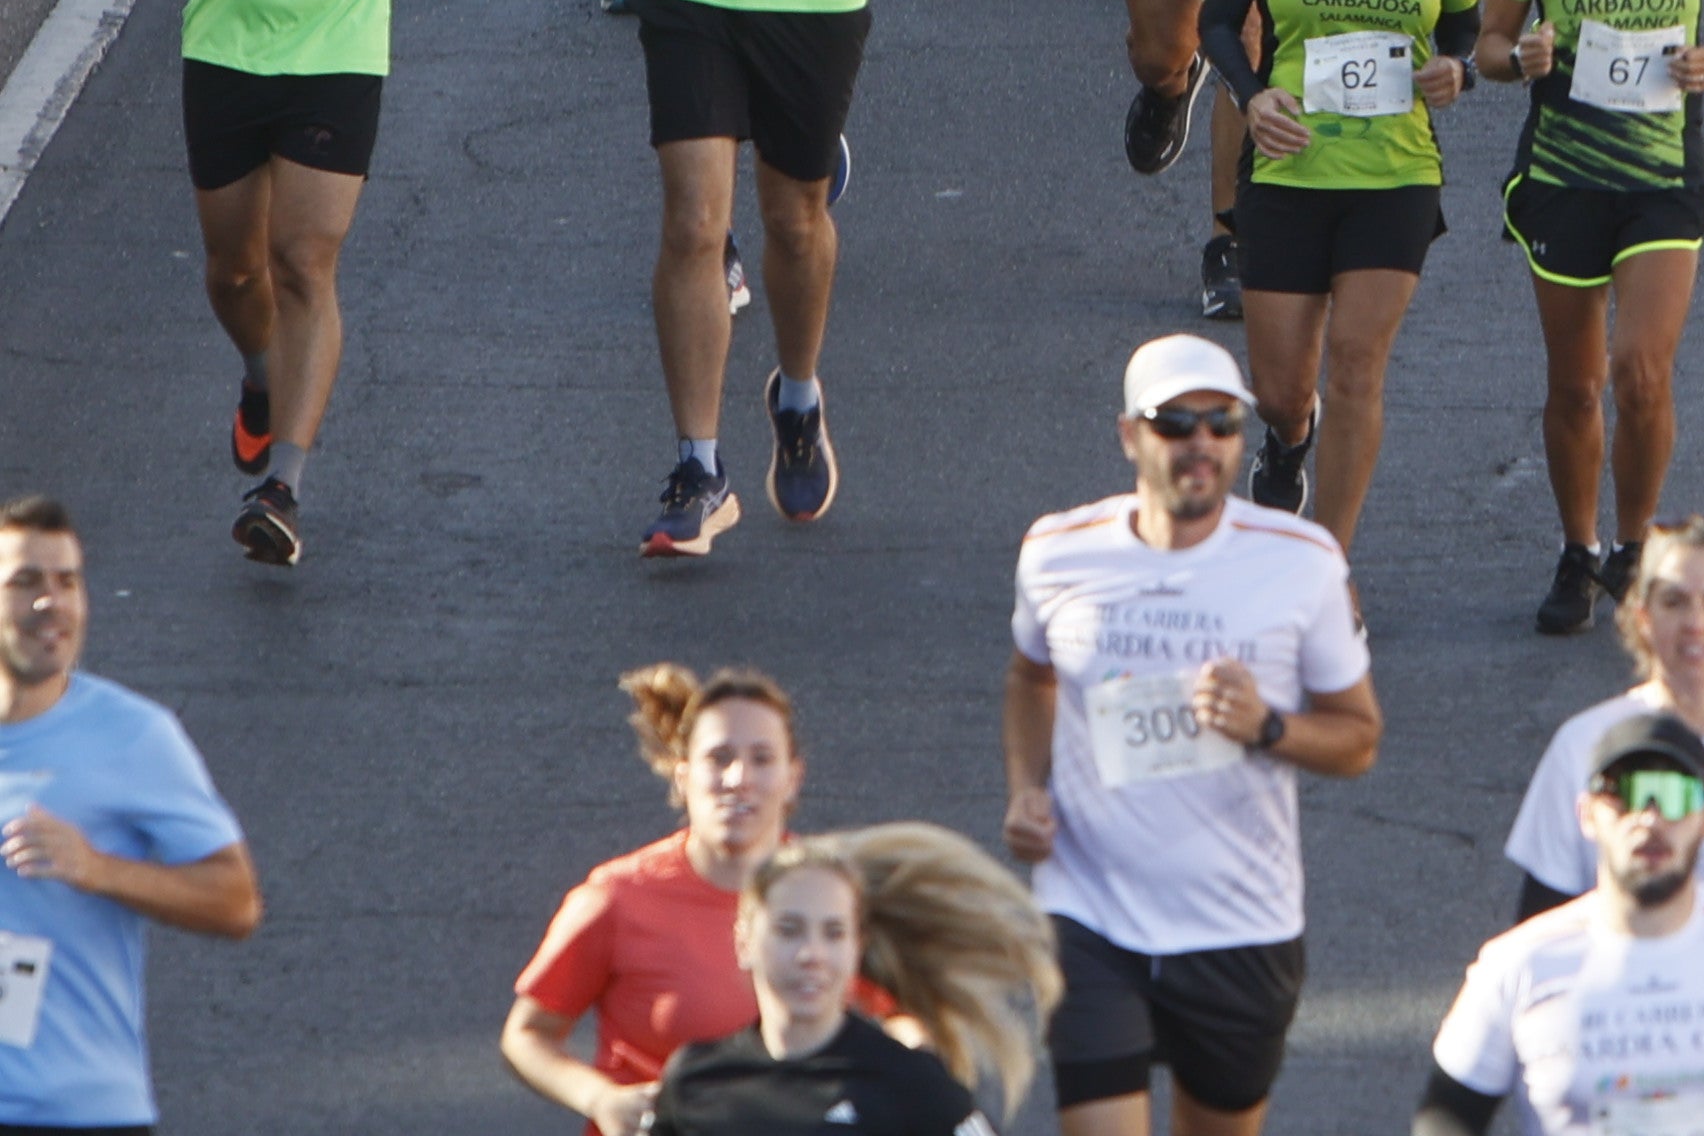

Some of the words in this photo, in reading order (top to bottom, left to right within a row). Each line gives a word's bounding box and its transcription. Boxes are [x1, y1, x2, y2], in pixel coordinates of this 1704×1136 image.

[1319, 12, 1403, 30] SALAMANCA
[1341, 59, 1377, 89] 62
[1609, 57, 1650, 86] 67
[1123, 705, 1200, 747] 300
